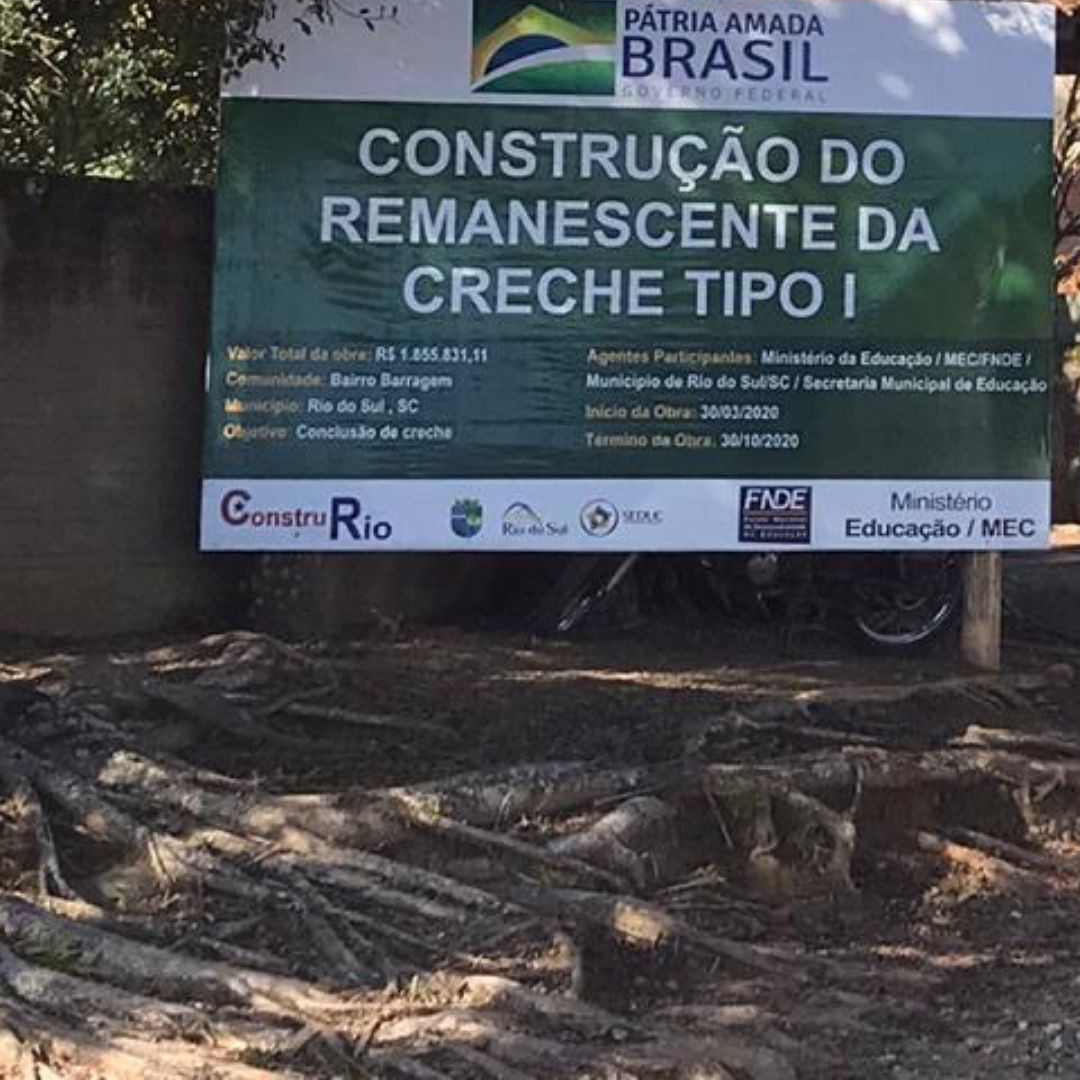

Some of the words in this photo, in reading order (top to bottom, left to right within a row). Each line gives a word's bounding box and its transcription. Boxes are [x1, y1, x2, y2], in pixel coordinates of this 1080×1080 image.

[624, 4, 717, 33] PÁTRIA
[724, 12, 825, 36] AMADA
[622, 35, 829, 83] BRASIL
[622, 84, 721, 100] GOVERNO
[735, 87, 827, 104] FEDERAL
[359, 124, 799, 192] CONSTRUÇÃO
[820, 138, 906, 186] DO
[320, 195, 836, 250] REMANESCENTE
[858, 205, 941, 253] DA
[403, 266, 664, 316] CRECHE
[685, 269, 823, 318] TIPO
[843, 273, 856, 318] I
[226, 347, 265, 361] Valor
[271, 347, 306, 361] Total
[310, 347, 329, 361] da
[375, 347, 397, 361] R$
[587, 348, 649, 366] Agentes
[761, 350, 834, 366] Ministério
[838, 351, 856, 366] da
[861, 350, 932, 368] Educação
[330, 372, 376, 387] Bairro
[381, 373, 452, 391] Barragem
[664, 374, 683, 389] de
[687, 374, 712, 389] Rio
[716, 375, 736, 389] do
[803, 375, 877, 390] Secretaria
[881, 376, 950, 394] Municipal
[954, 378, 973, 392] de
[976, 377, 1048, 394] Educação
[308, 398, 333, 413] Rio
[337, 398, 356, 413] do
[360, 398, 386, 413] Sul
[398, 398, 419, 413] SC
[631, 404, 650, 419] da
[701, 404, 780, 420] 30/03/2020
[296, 424, 376, 440] Conclusão
[402, 425, 452, 441] creche
[720, 433, 799, 449] 30/10/2020
[744, 487, 808, 510] FNDE
[890, 491, 993, 512] Ministério
[845, 517, 961, 542] Educação
[966, 519, 974, 538] /
[981, 519, 1036, 538] MEC
